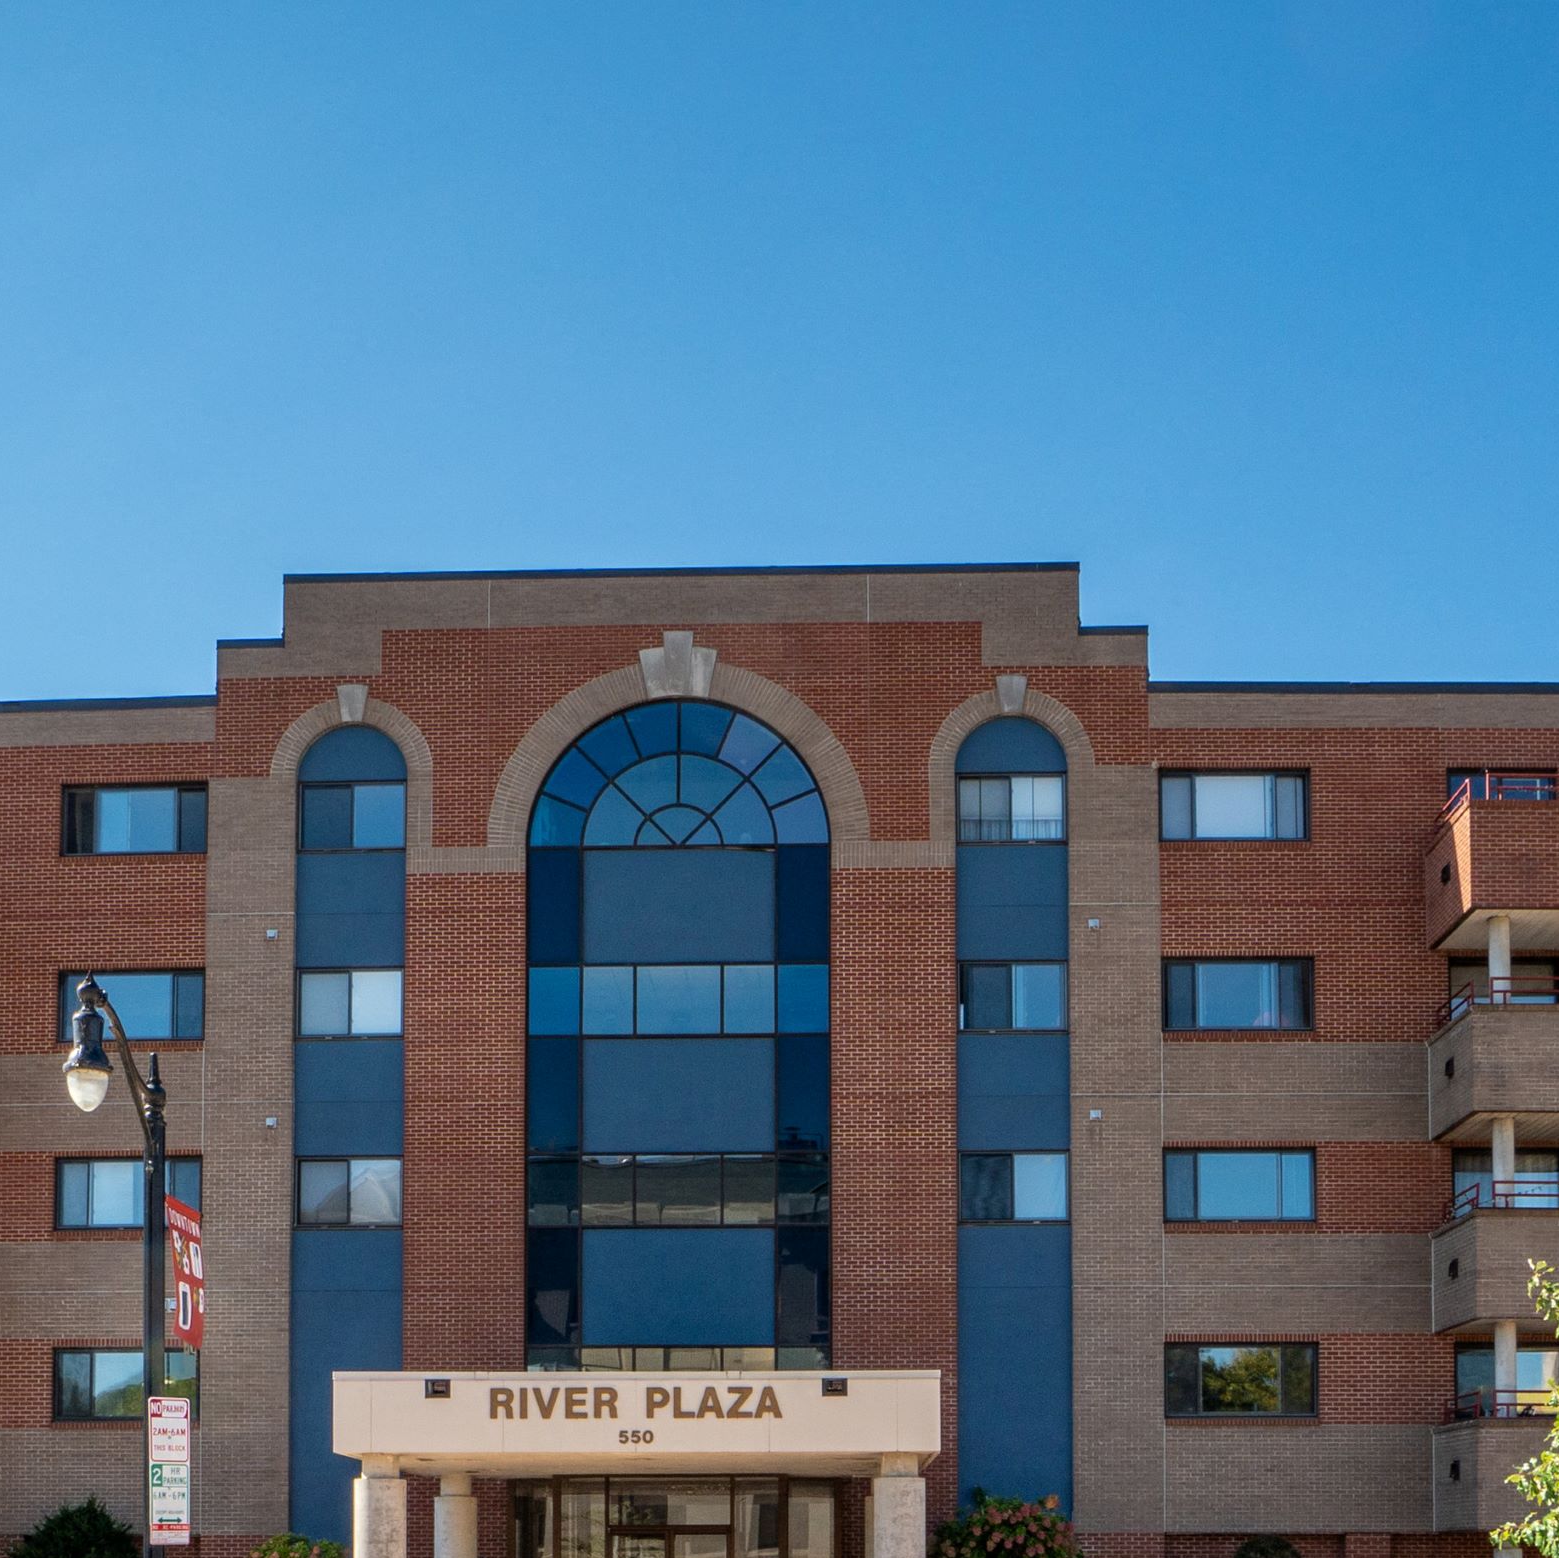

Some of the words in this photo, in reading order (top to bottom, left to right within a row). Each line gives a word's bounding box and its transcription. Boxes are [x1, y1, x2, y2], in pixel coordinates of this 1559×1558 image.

[150, 1401, 162, 1415] NO
[489, 1386, 619, 1420] RIVER
[645, 1386, 783, 1419] PLAZA
[618, 1429, 655, 1444] 550
[152, 1467, 162, 1484] 2
[163, 1476, 187, 1486] PARKING
